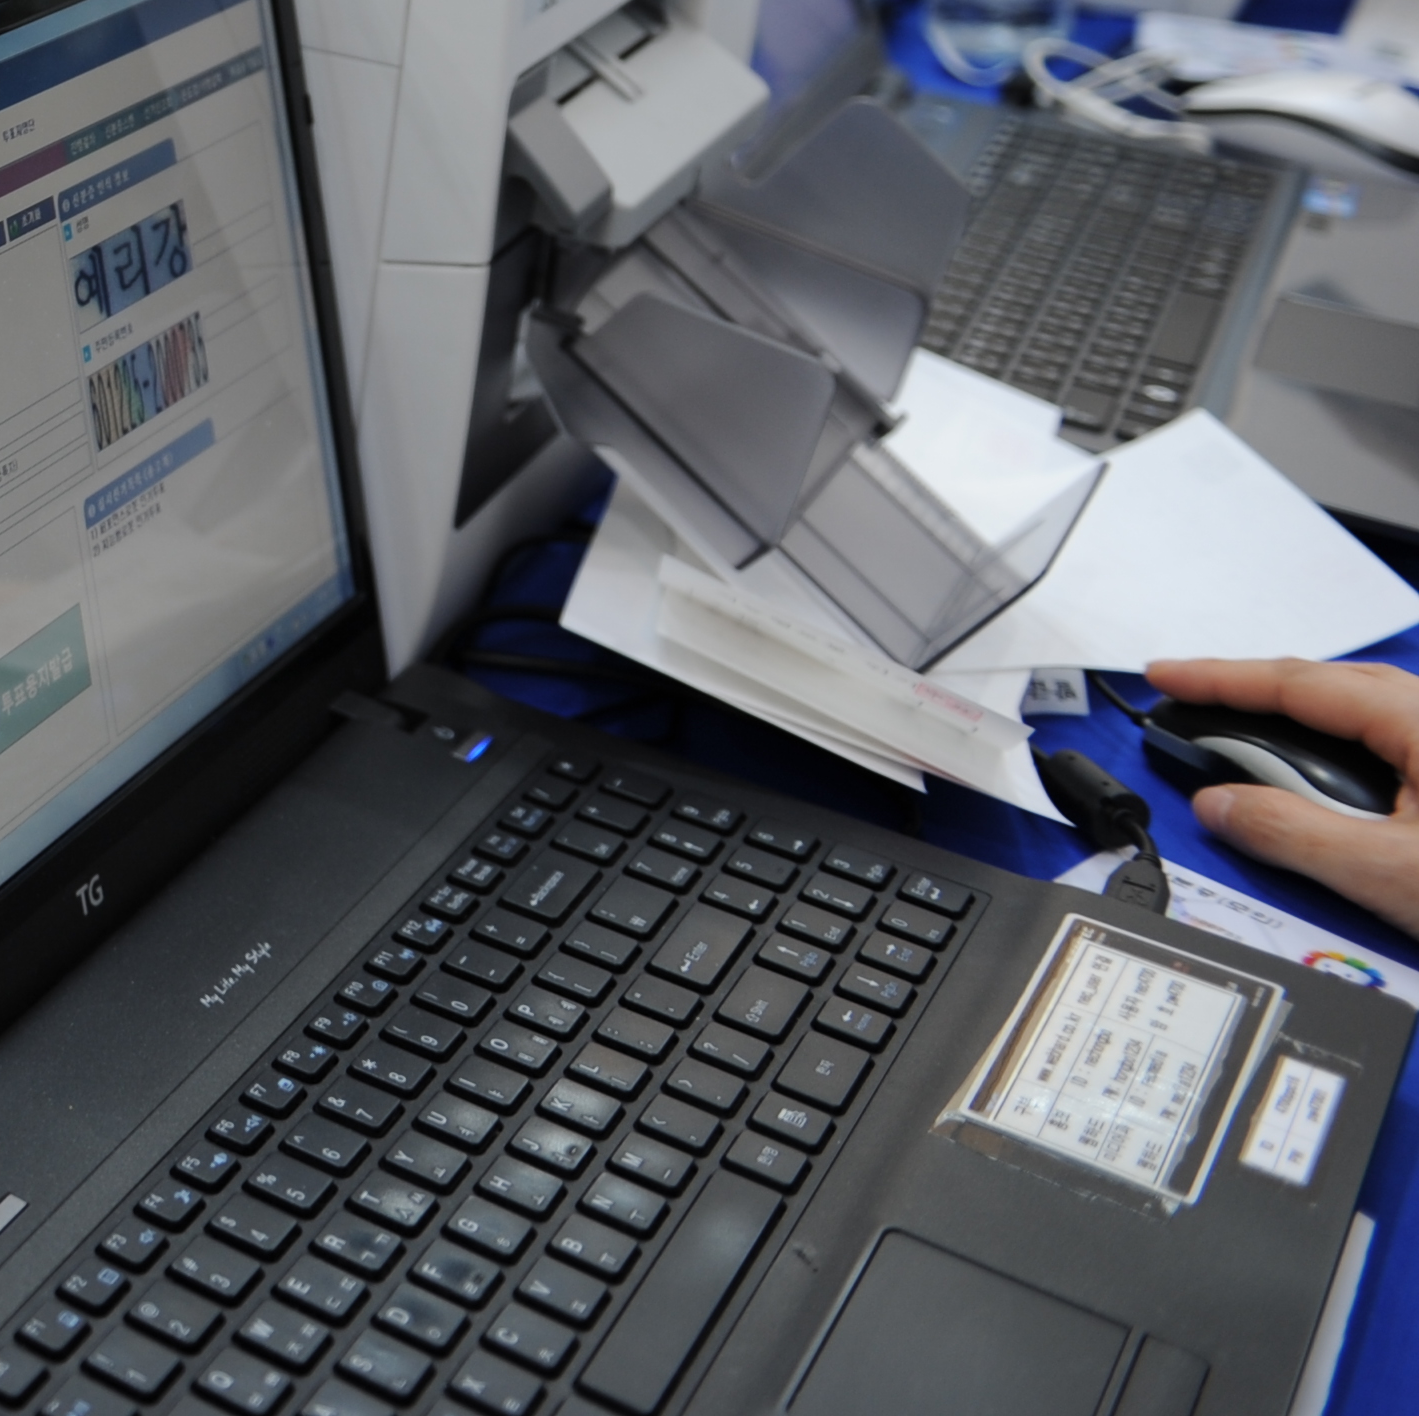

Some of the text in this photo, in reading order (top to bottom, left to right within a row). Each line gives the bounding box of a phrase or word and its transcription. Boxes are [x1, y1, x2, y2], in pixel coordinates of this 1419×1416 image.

[74, 202, 188, 318] 예리강
[0, 646, 74, 716] 투표용지발급
[75, 876, 105, 916] TG
[199, 993, 224, 1008] My
[230, 963, 255, 977] My
[244, 942, 272, 965] Style
[683, 939, 712, 962] Enter
[1116, 994, 1143, 1021] 사용자
